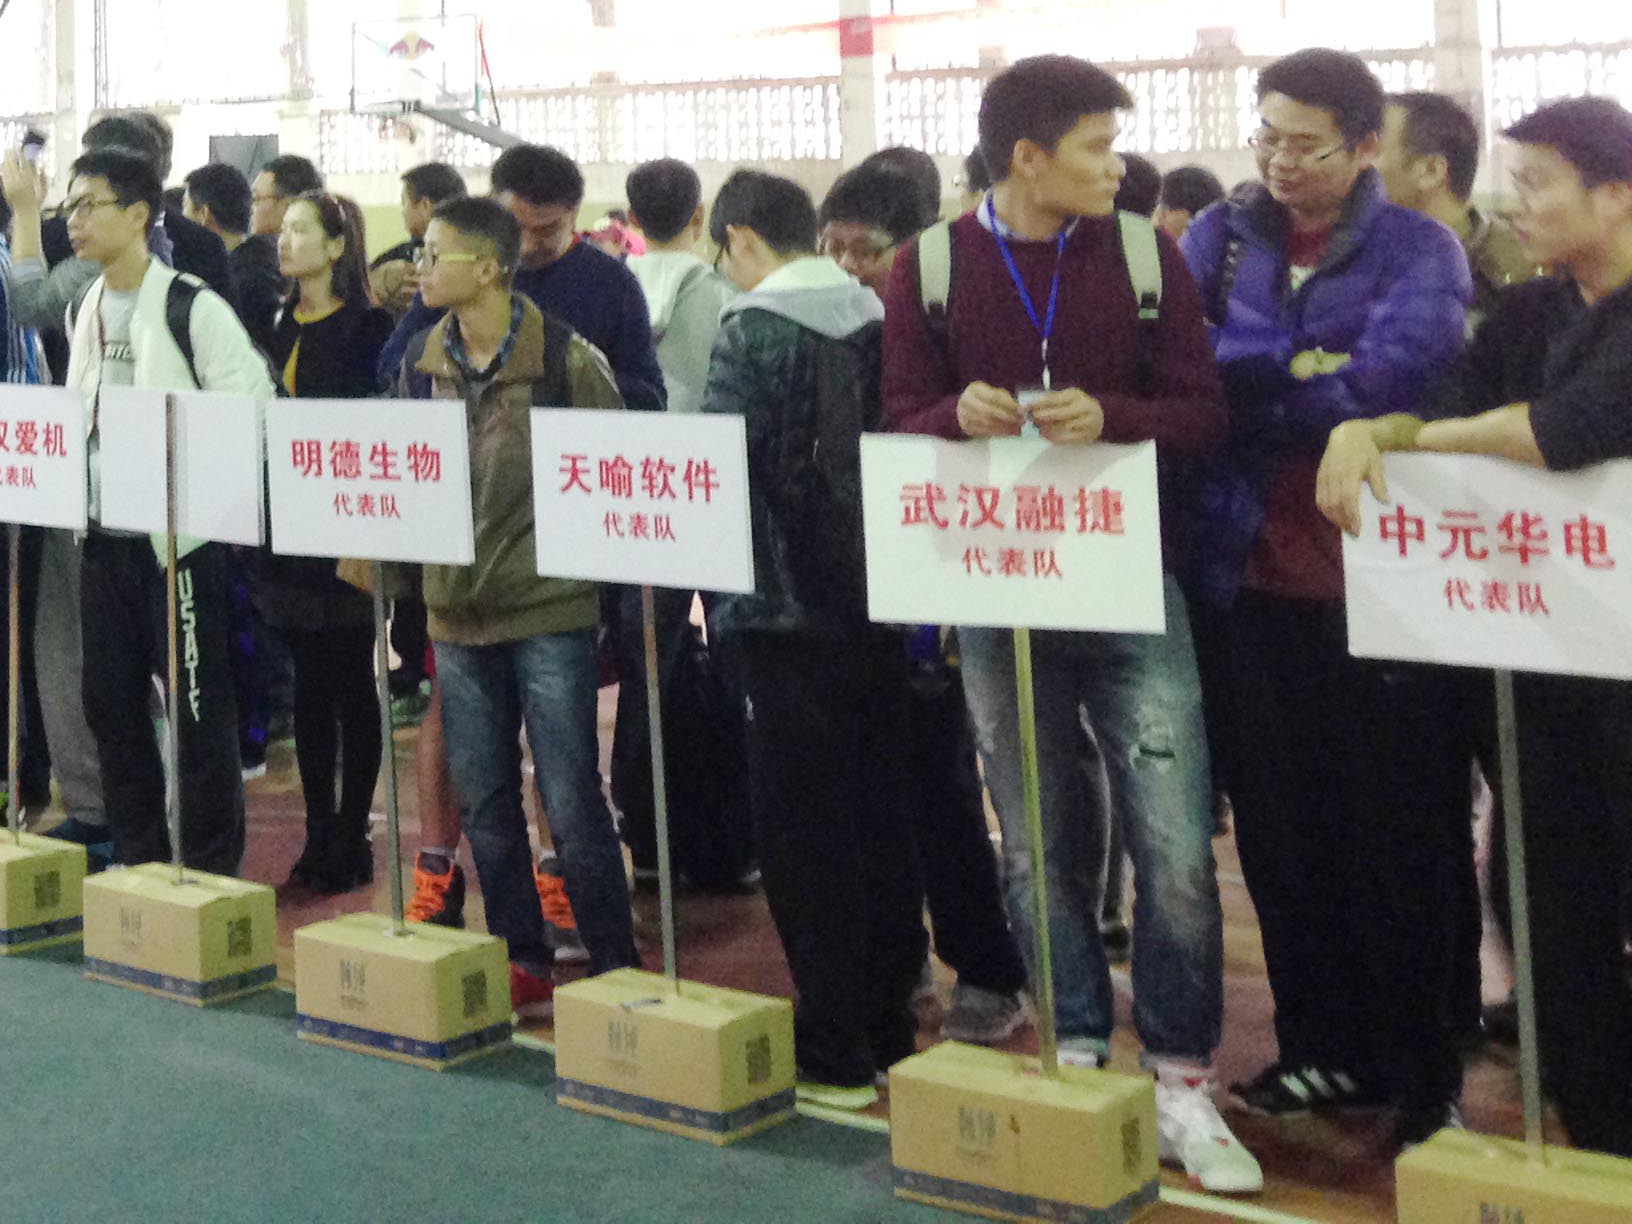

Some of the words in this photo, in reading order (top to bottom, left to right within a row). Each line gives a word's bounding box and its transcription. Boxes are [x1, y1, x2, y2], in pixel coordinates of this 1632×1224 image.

[291, 439, 442, 482] 明德生物
[559, 453, 719, 504] 天喻软件
[333, 493, 400, 516] 代表队
[900, 482, 1125, 536] 武汉融捷
[603, 511, 676, 542] 代表队
[1378, 503, 1616, 570] 中元华电
[963, 546, 1062, 576] 代表队
[1444, 579, 1548, 613] 代表队
